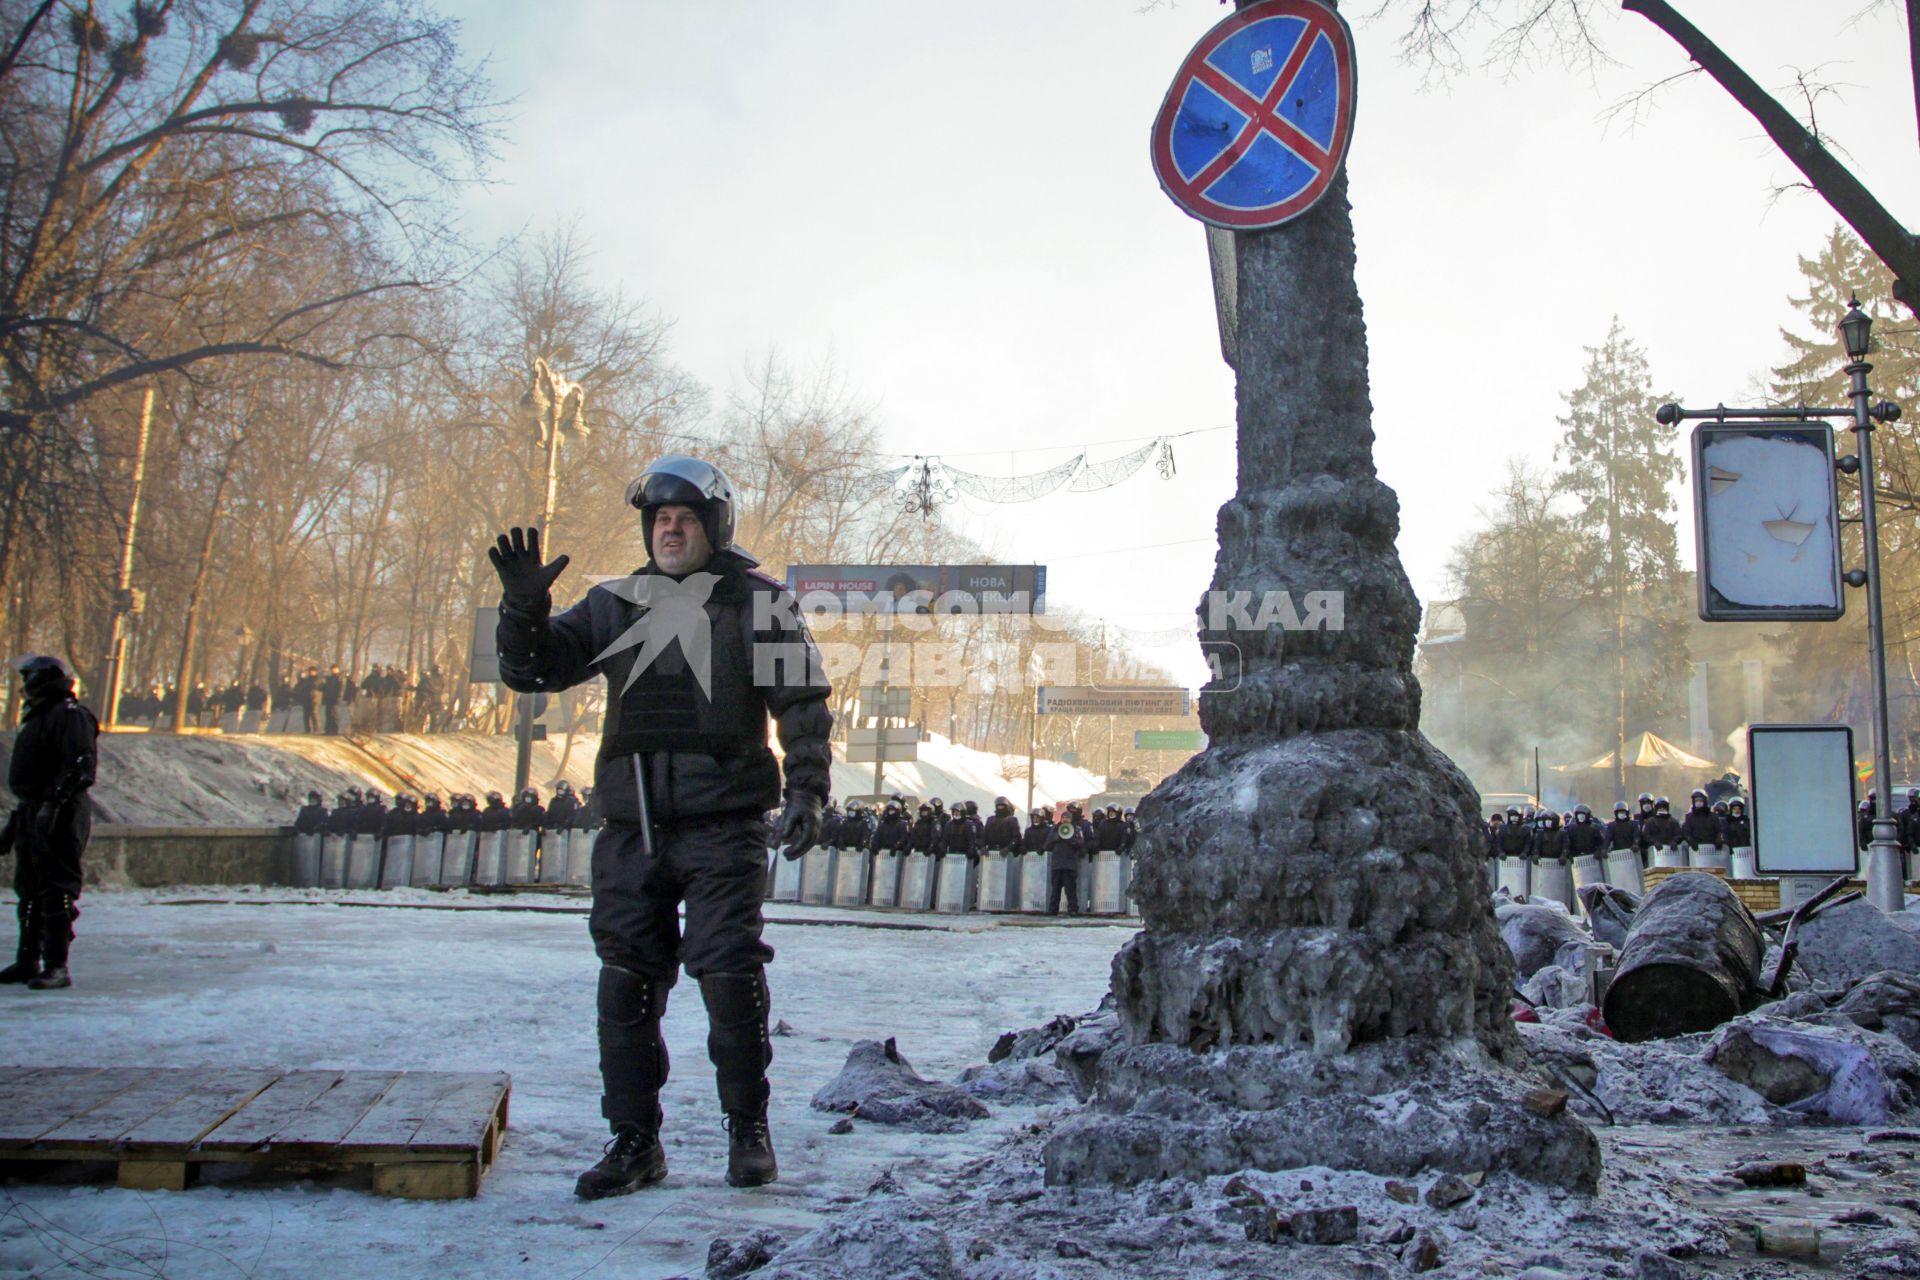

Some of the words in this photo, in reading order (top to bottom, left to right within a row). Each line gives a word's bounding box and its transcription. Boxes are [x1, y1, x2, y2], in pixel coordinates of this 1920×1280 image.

[805, 581, 835, 590] LAPIN
[838, 581, 873, 590] HOUSE
[969, 577, 1006, 588] НОВА
[954, 593, 1020, 603] КОЛЕКЦІЯ
